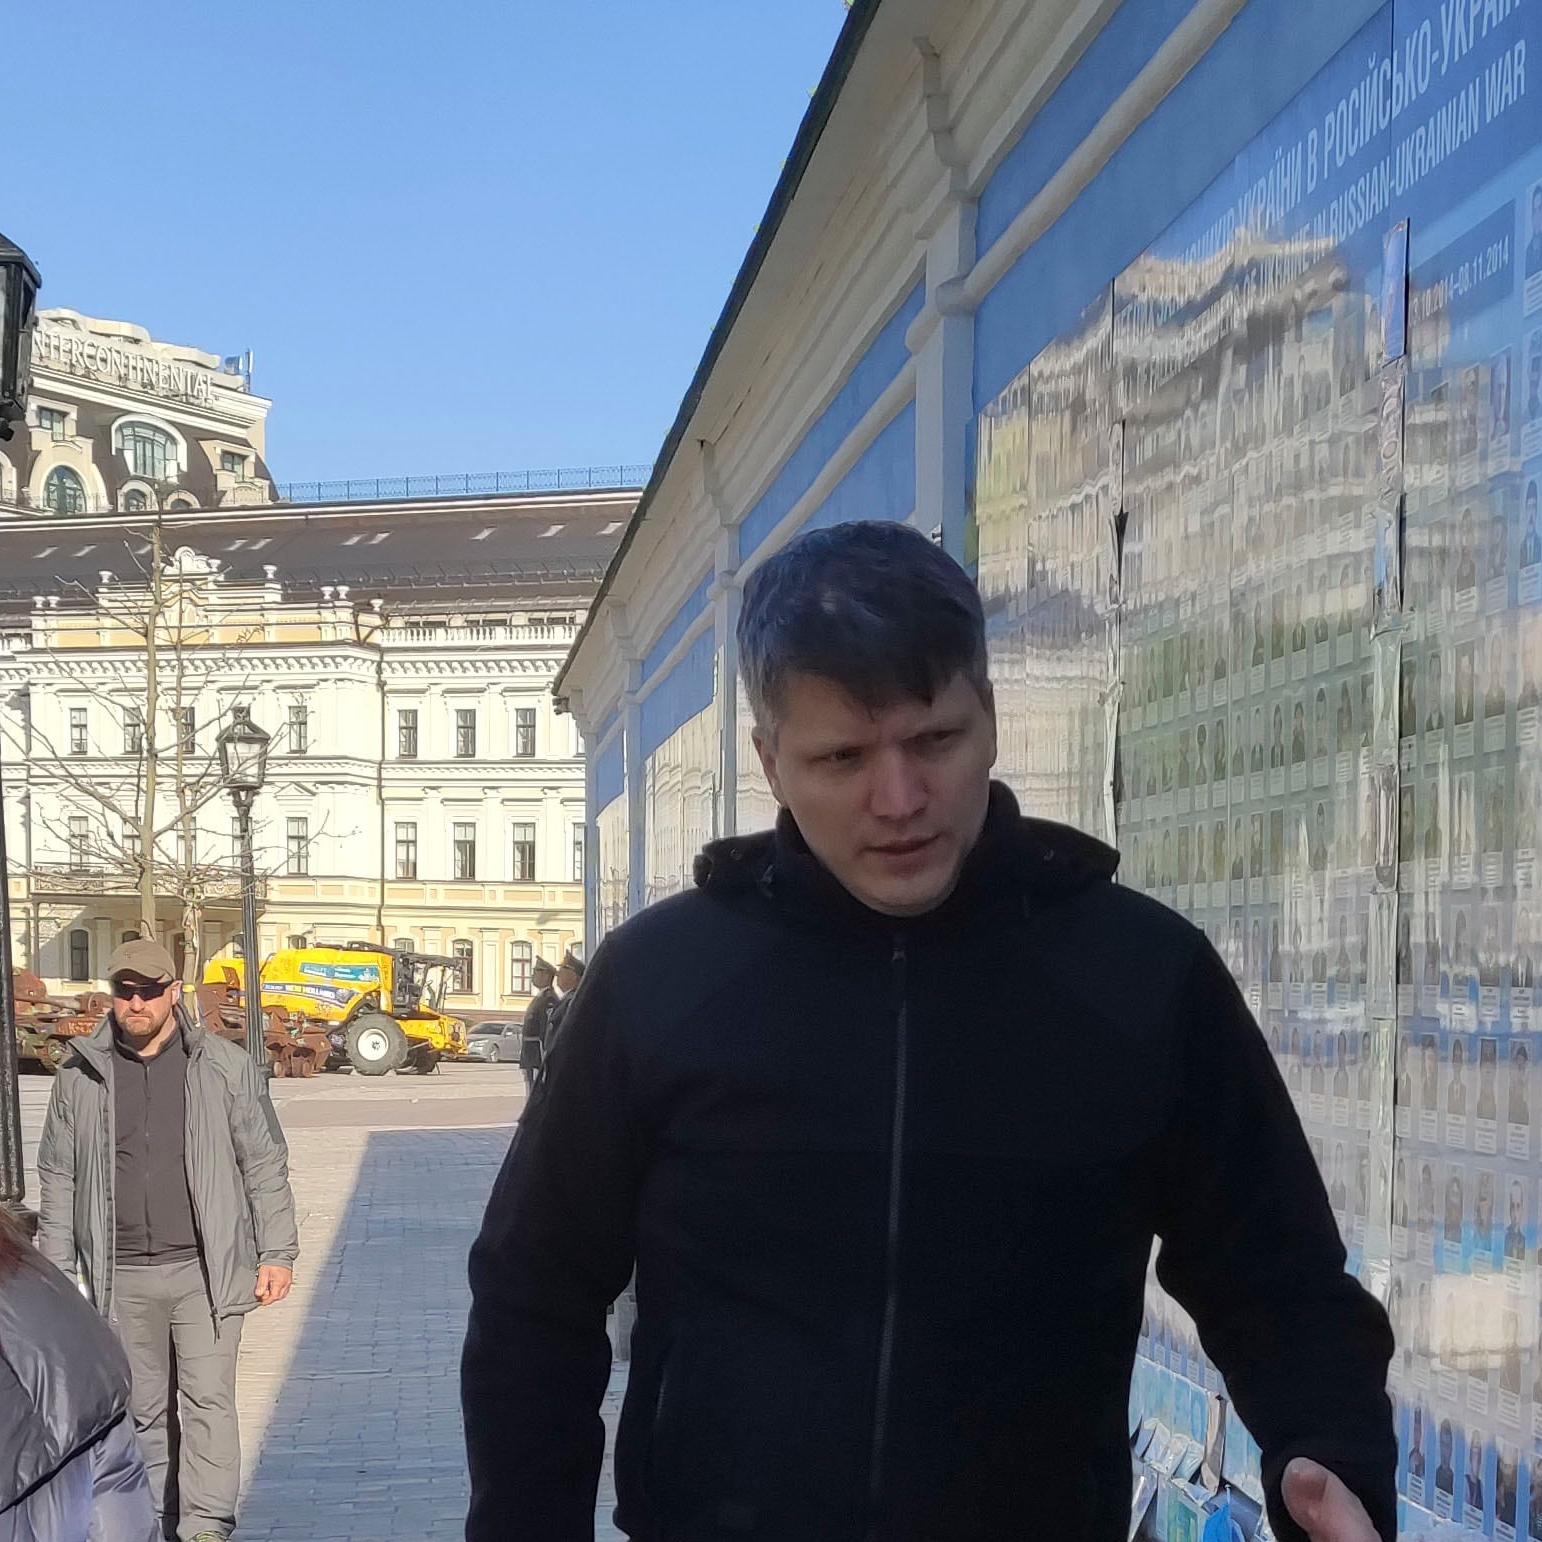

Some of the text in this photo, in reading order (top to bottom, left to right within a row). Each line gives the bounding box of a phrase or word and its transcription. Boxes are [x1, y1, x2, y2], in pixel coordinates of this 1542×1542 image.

[1239, 141, 1302, 243] УКРАЇНИ
[1307, 127, 1318, 195] В
[1330, 77, 1479, 247] RUSSIAN-UKRAINIAN
[1486, 39, 1526, 125] WAR
